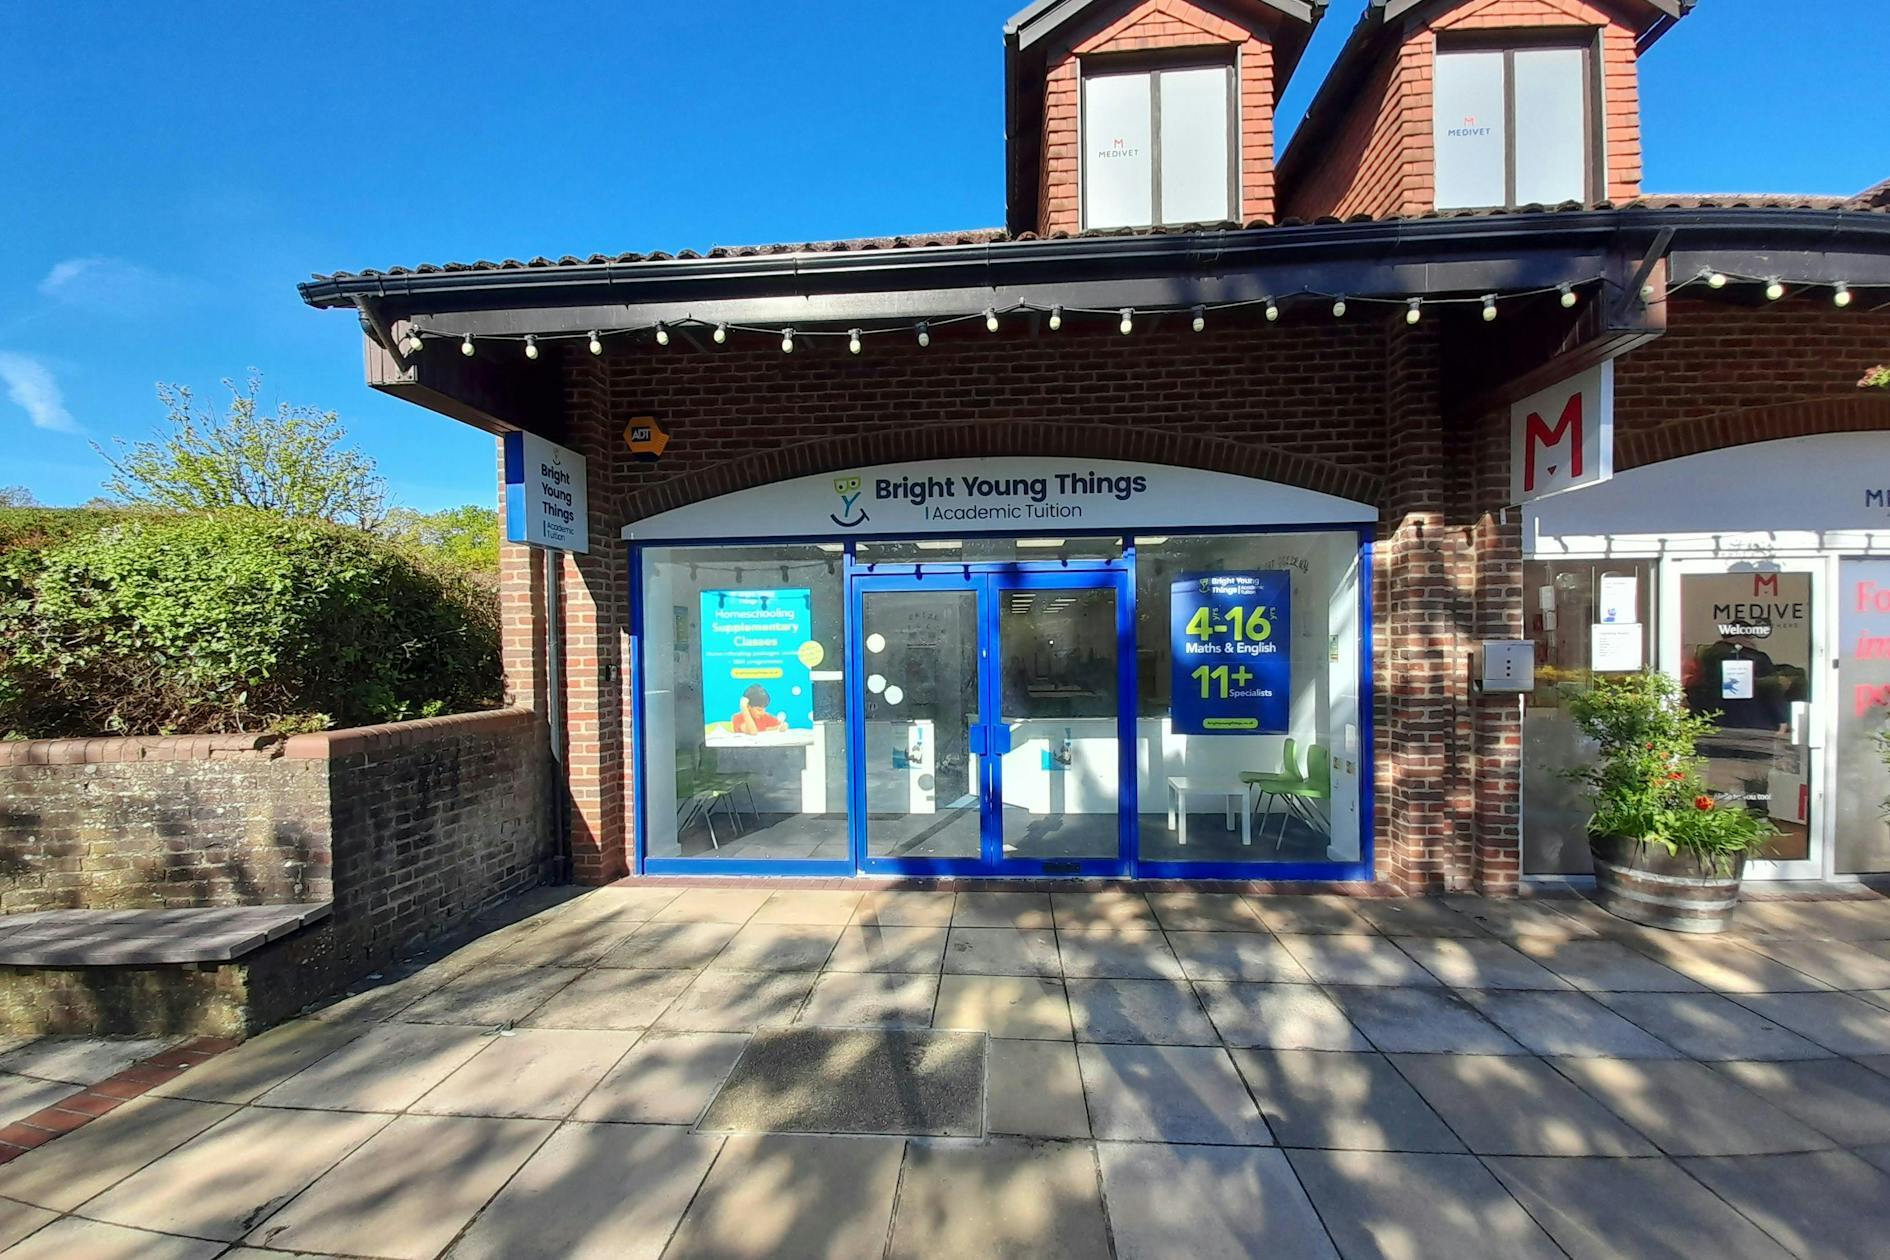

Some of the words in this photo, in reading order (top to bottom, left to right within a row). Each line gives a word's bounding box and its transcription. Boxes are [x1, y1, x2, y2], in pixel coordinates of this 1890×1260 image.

[1448, 128, 1491, 137] MEDIVET
[1098, 149, 1139, 158] MEDIVET
[632, 428, 649, 440] ADT
[1524, 391, 1583, 492] M
[541, 463, 570, 485] Bright
[541, 482, 572, 507] Young
[875, 475, 954, 506] Bright
[961, 475, 1047, 502] Young
[1054, 470, 1147, 501] Things
[1866, 488, 1890, 507] M
[542, 501, 575, 524] Things
[932, 504, 1021, 521] Academic
[1026, 503, 1083, 519] Tuition
[547, 522, 575, 536] Academic
[1212, 576, 1235, 587] Bright
[1236, 577, 1260, 586] Young
[715, 608, 795, 621] Homeschooling
[712, 622, 799, 635] Supplementary
[1718, 624, 1771, 636] Welcome
[733, 636, 778, 647] Classes
[1185, 642, 1222, 654] Maths
[1224, 642, 1234, 654] &
[1237, 642, 1277, 656] English
[1192, 665, 1254, 699] 11+
[1229, 688, 1273, 699] Specialists
